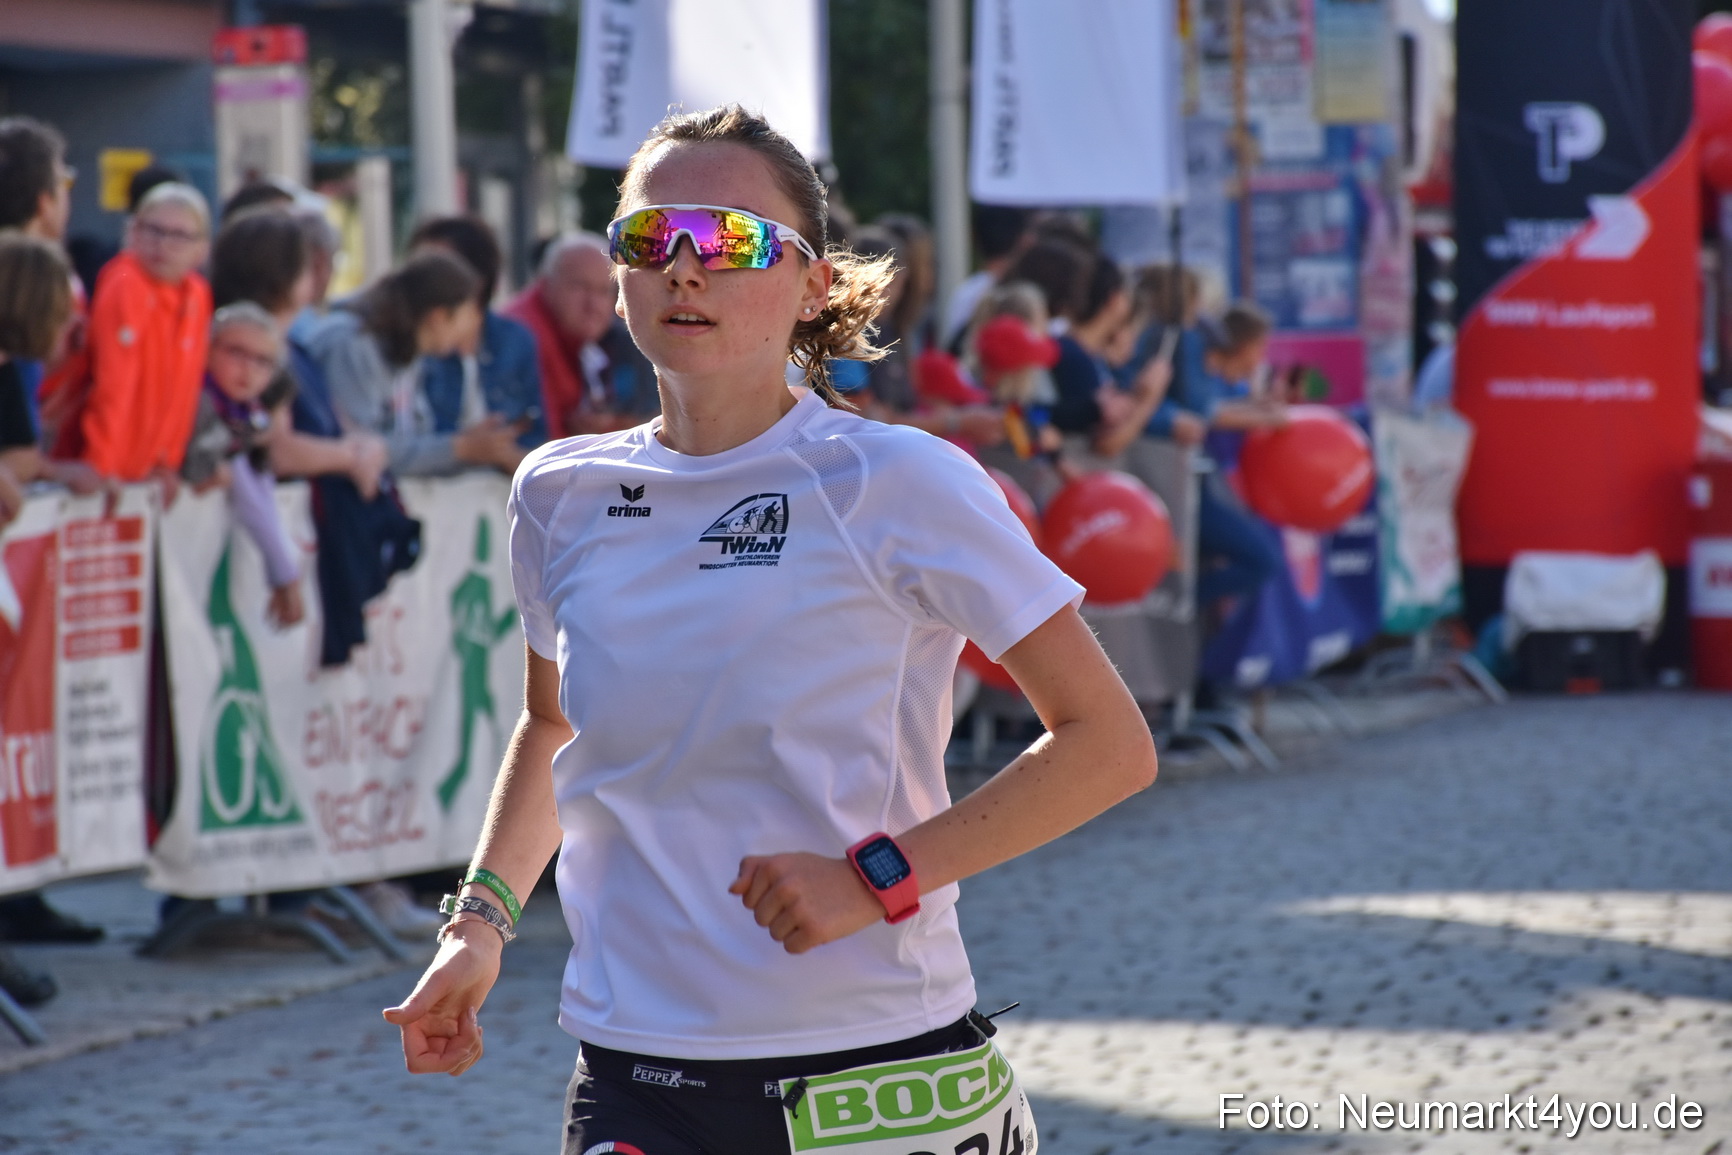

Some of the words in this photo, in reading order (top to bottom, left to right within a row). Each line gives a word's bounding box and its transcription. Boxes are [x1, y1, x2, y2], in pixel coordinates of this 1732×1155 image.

[607, 504, 651, 517] erima
[632, 1065, 683, 1088] PEPPEX
[678, 1077, 707, 1088] SPORTS
